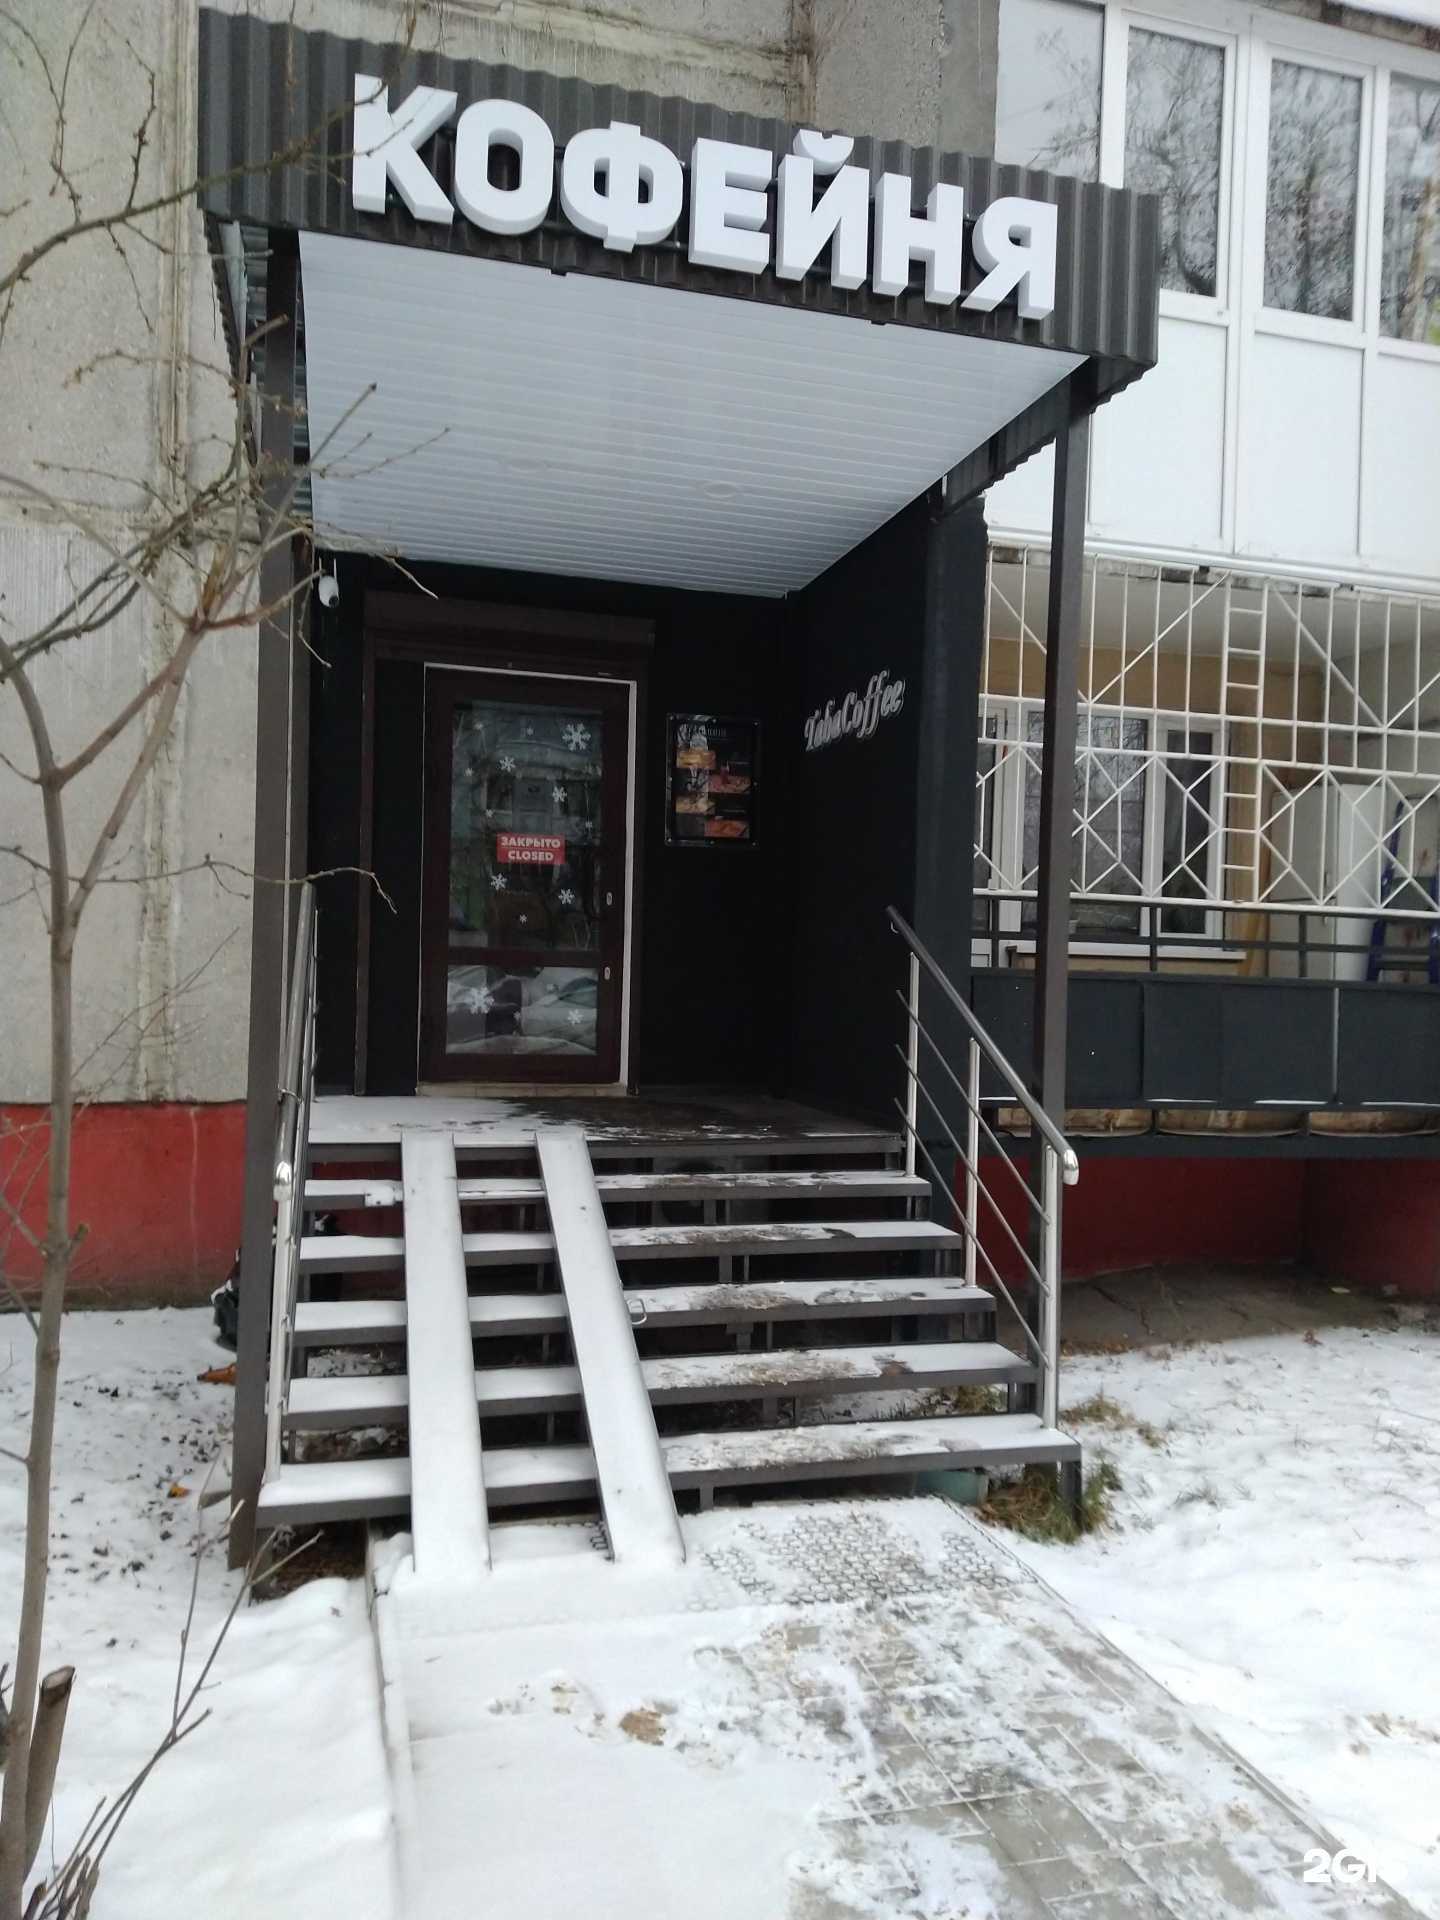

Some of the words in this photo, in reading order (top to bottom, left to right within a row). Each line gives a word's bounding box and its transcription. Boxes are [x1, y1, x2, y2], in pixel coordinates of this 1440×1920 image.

[352, 73, 1058, 320] КОФЕЙНЯ
[501, 836, 561, 848] ЗАКРЫТО
[508, 850, 554, 861] CLOSED
